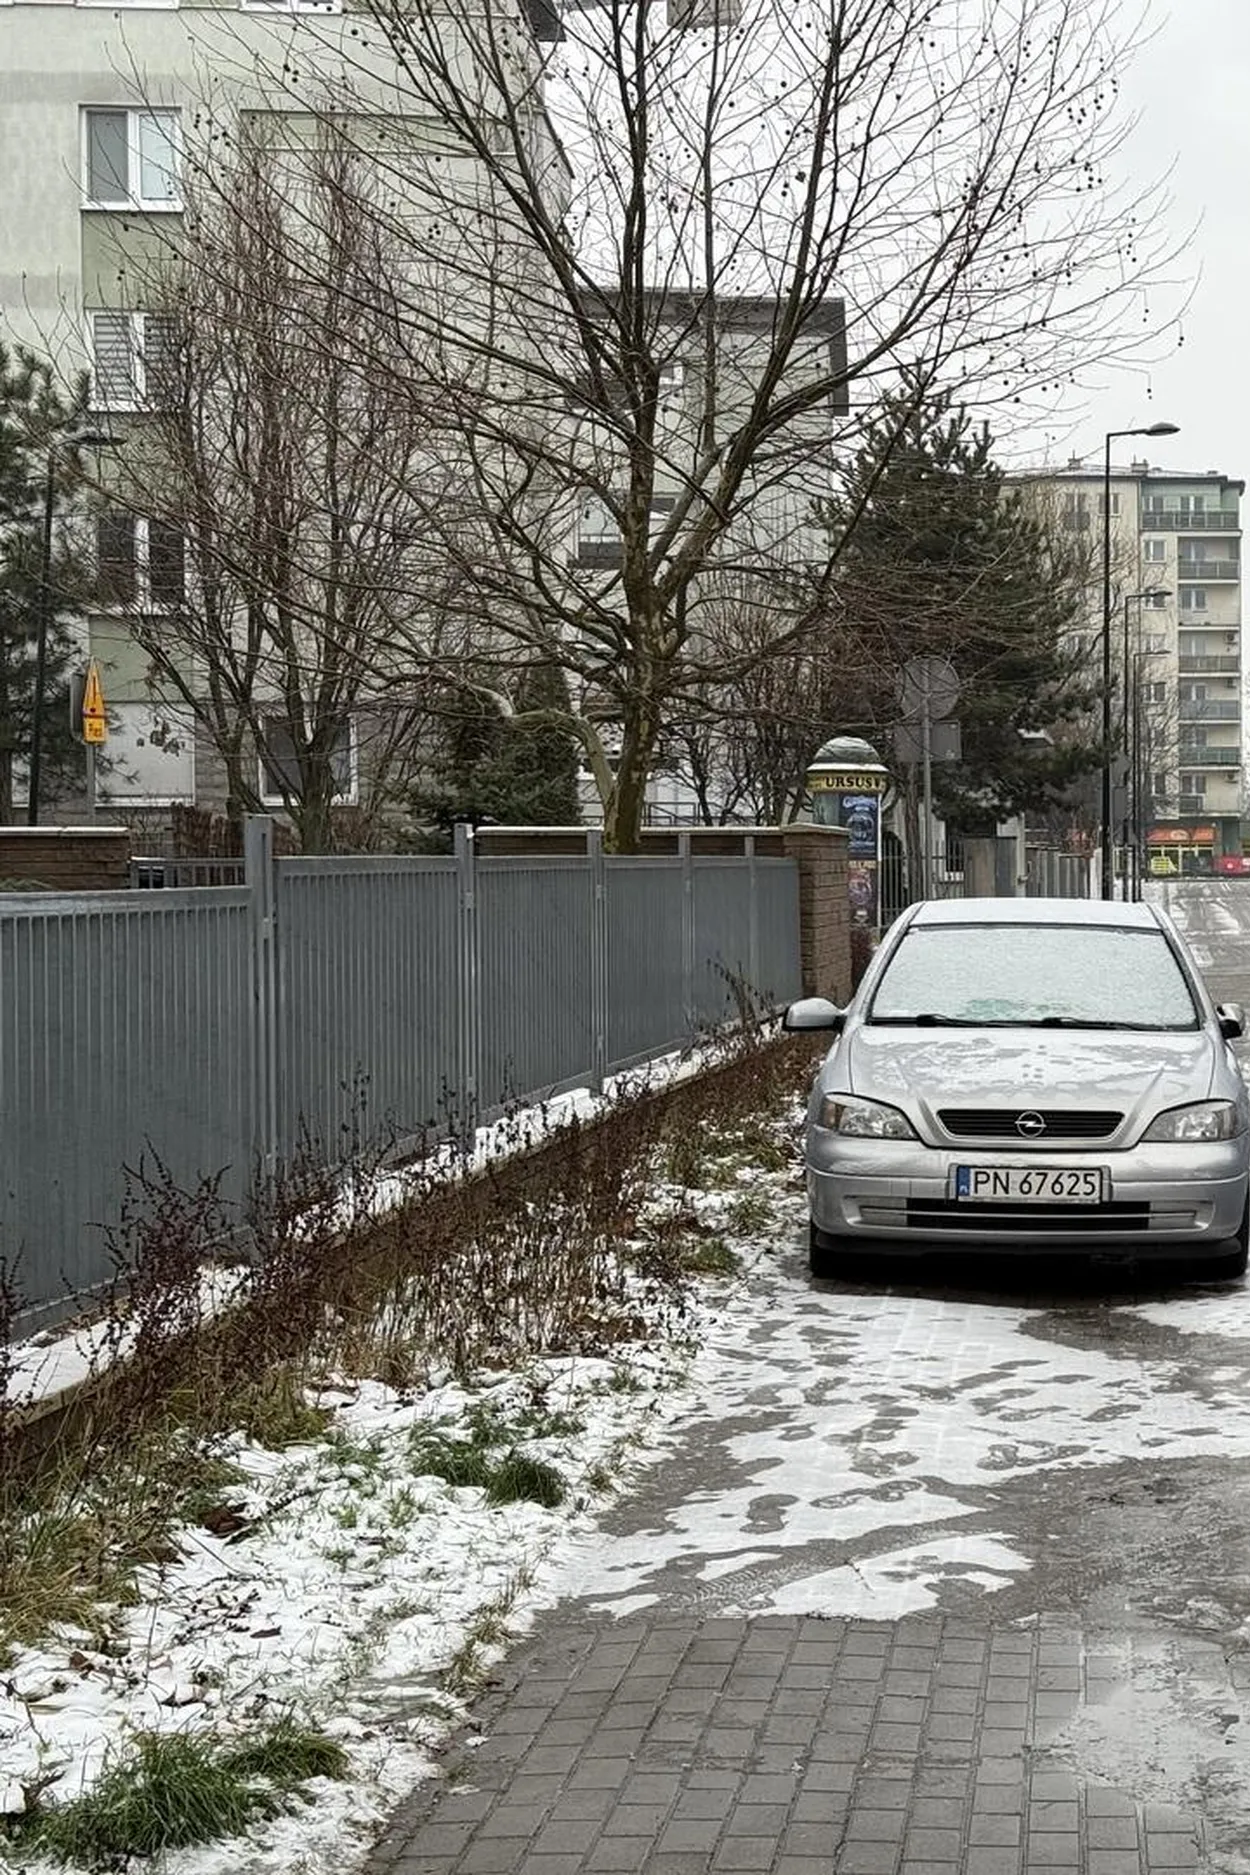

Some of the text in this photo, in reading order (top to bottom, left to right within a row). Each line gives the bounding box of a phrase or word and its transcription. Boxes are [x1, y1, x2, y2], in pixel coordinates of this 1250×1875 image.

[825, 776, 872, 788] URSUS
[974, 1170, 1096, 1196] PN 67625
